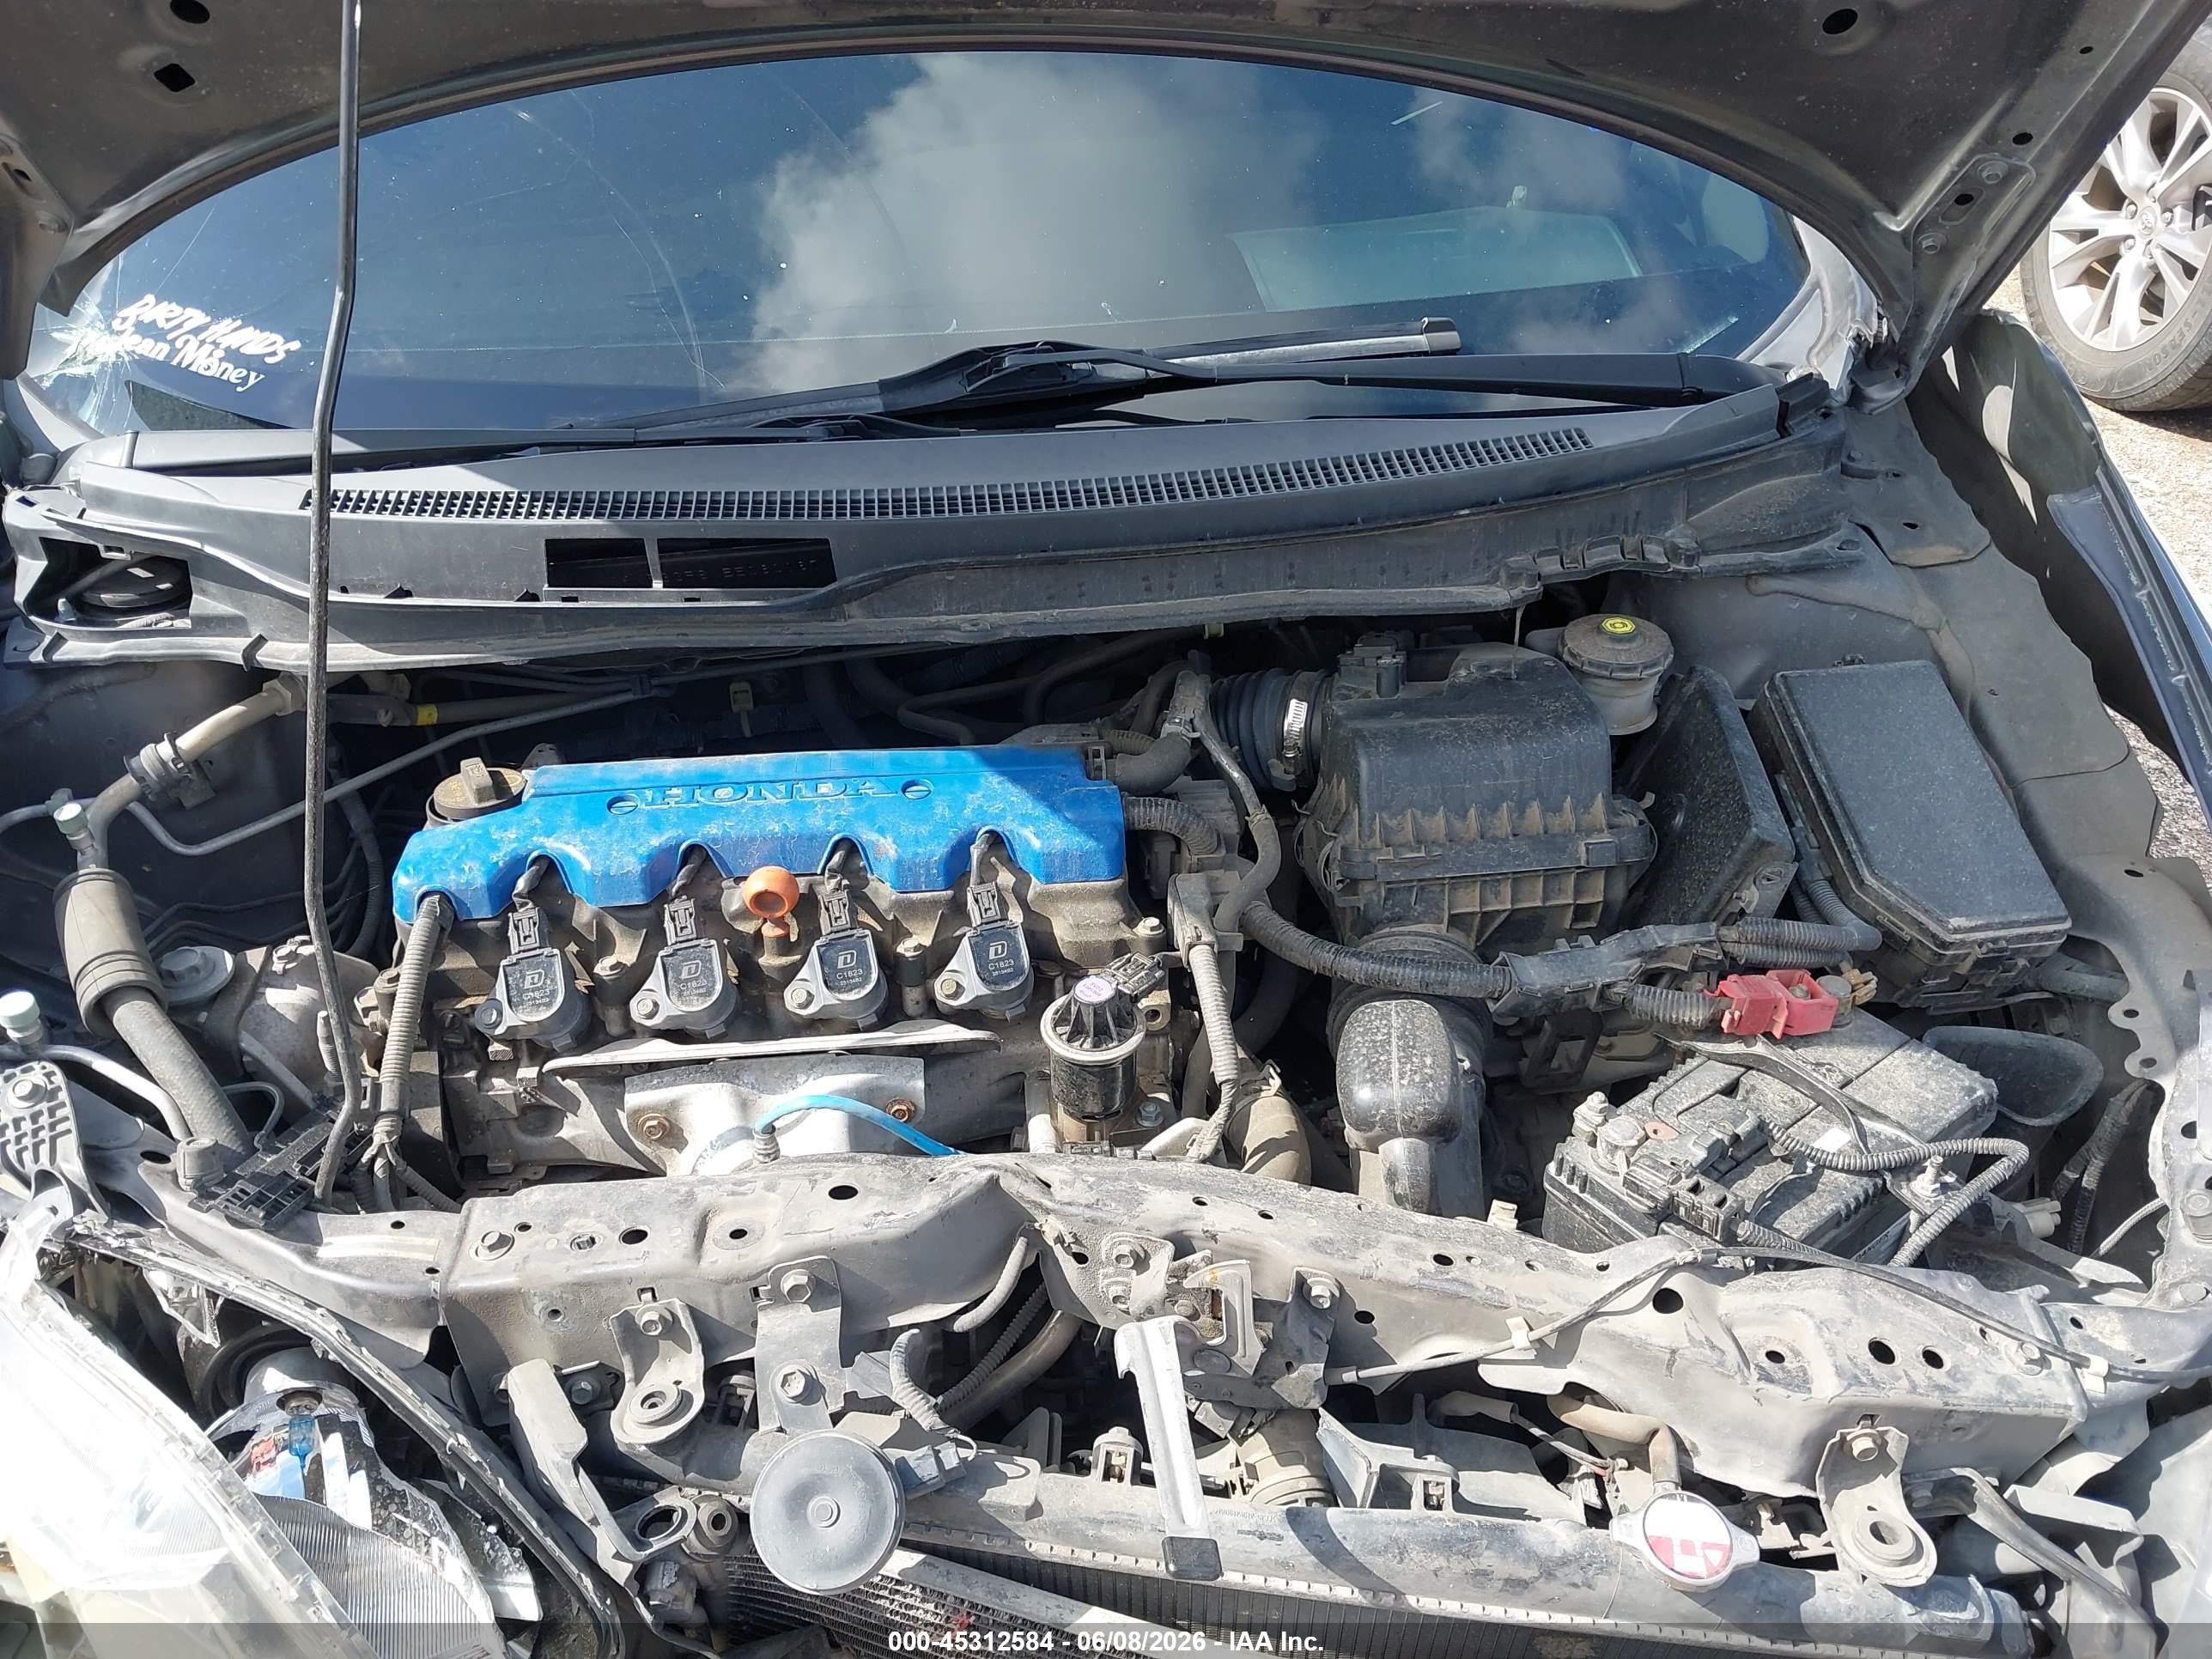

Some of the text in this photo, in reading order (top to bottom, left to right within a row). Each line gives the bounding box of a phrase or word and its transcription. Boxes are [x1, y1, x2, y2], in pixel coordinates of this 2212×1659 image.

[112, 295, 301, 364] DIRTY HANDS
[171, 334, 265, 392] Money
[643, 778, 898, 810] HONDA
[836, 968, 863, 980] C1823
[988, 958, 1014, 970] C1823
